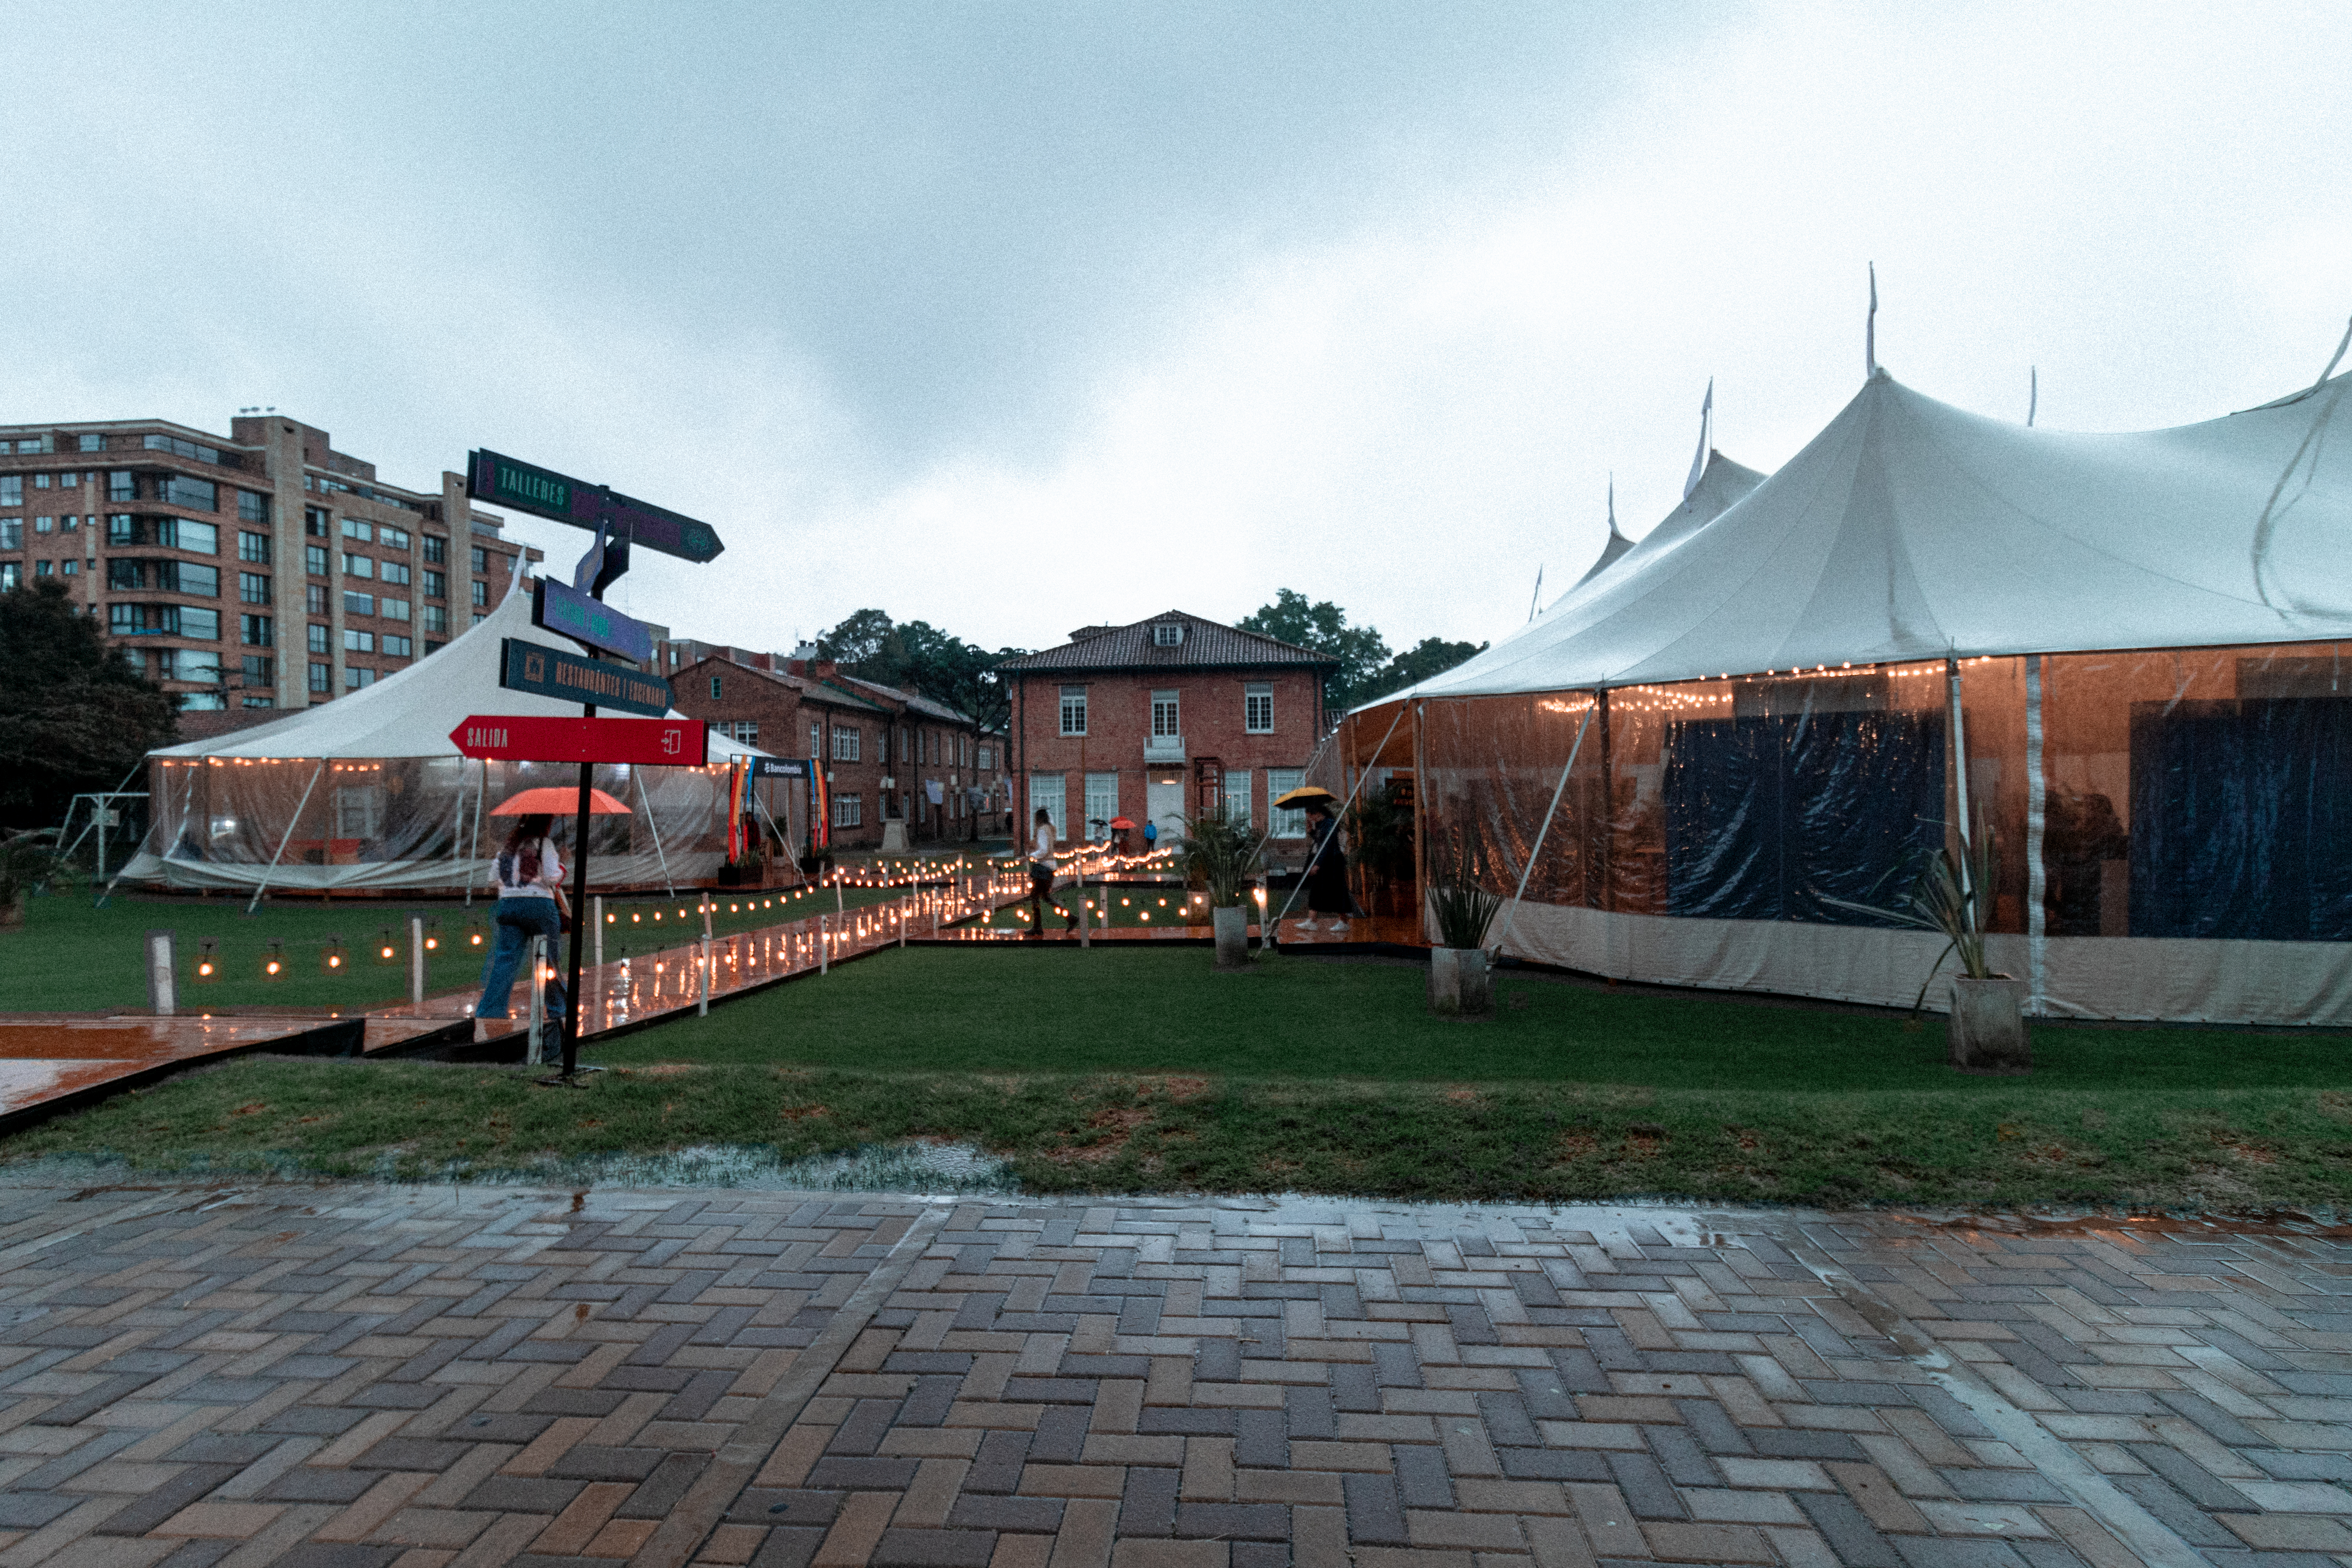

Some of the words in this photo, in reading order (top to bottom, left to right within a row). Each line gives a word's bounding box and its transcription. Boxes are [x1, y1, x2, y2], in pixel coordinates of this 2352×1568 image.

[502, 467, 564, 505] TALLERES
[555, 662, 620, 697] RESTAURANTES
[467, 728, 508, 747] SALIDA
[770, 762, 802, 774] Bancolombia
